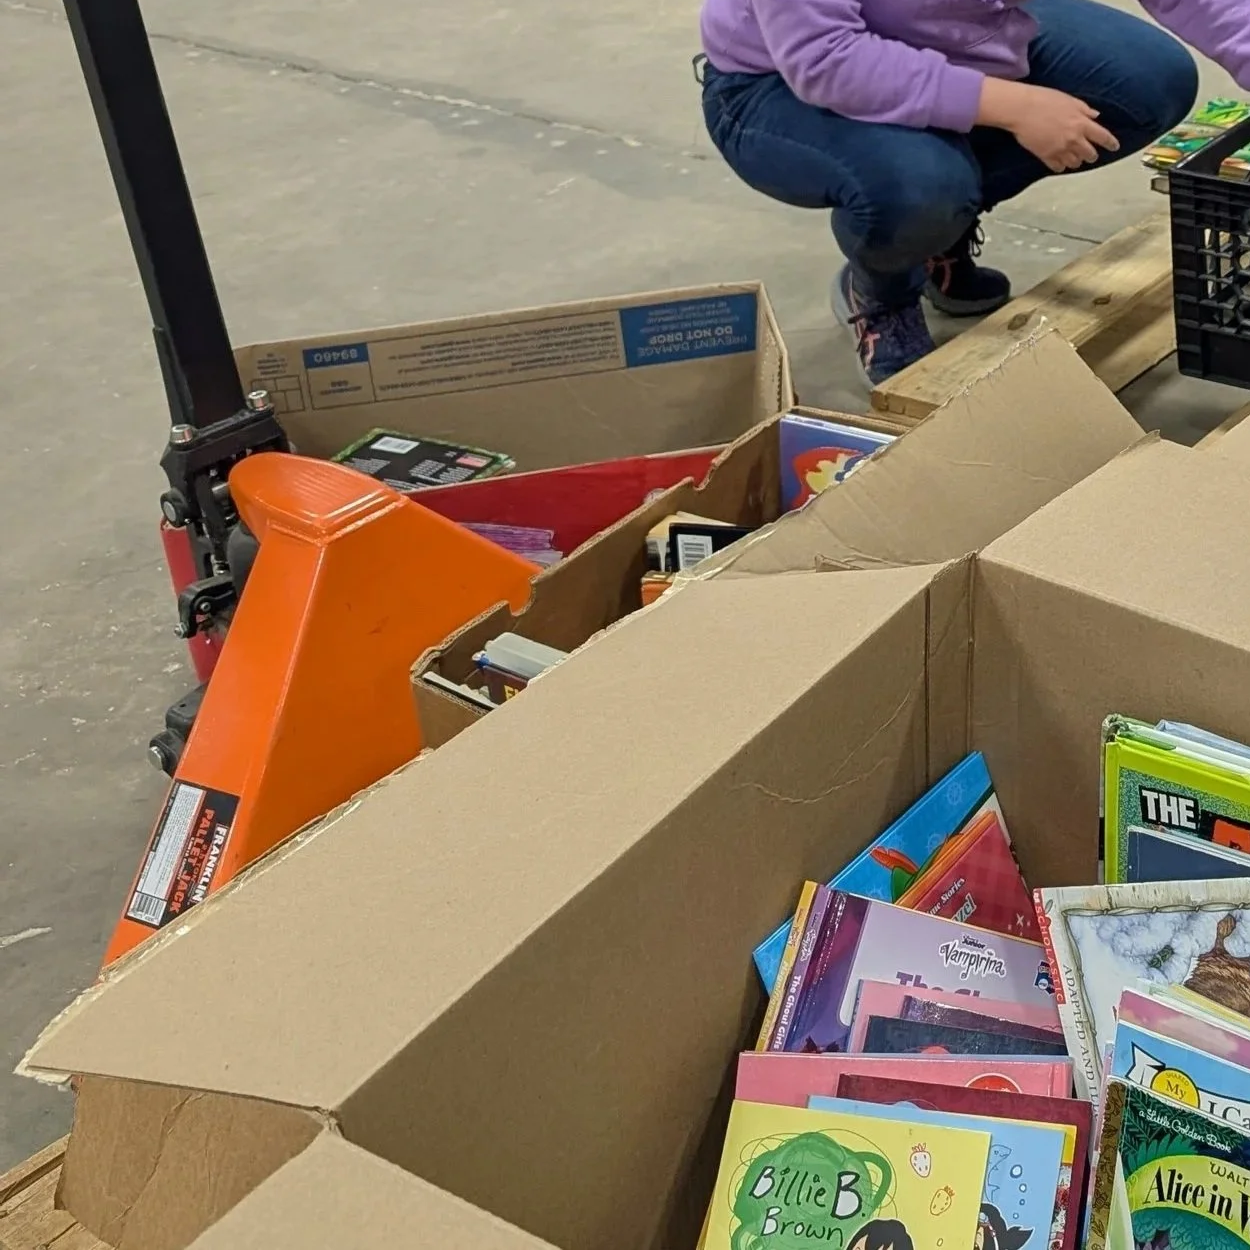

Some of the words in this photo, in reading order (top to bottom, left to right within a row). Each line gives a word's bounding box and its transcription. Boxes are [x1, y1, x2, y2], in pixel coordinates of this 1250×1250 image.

[649, 332, 683, 345] DROP
[687, 328, 712, 340] NOT
[694, 335, 748, 351] PREVENT
[714, 325, 733, 337] DO
[638, 340, 690, 358] DAMAGE
[1141, 789, 1198, 829] THE
[187, 808, 215, 867] PALLET
[191, 825, 228, 903] FRANKLIN
[169, 871, 192, 913] JACK
[940, 877, 966, 906] Stories
[961, 937, 986, 950] Junior
[1035, 905, 1064, 1003] SCHOLASTIC
[939, 941, 1006, 980] Vampirina
[789, 975, 802, 995] The
[782, 995, 796, 1027] Ghoul
[1063, 964, 1086, 1040] ADAPTED
[1080, 1046, 1095, 1081] AND
[773, 1026, 786, 1050] Girls
[1165, 1079, 1188, 1099] My
[1146, 1107, 1171, 1128] Little
[1171, 1119, 1205, 1143] Golden
[1206, 1132, 1232, 1154] Book
[1209, 1160, 1250, 1188] WALT
[749, 1165, 827, 1208] Billie
[831, 1170, 867, 1220] B.
[1142, 1165, 1206, 1207] Alice
[1209, 1184, 1235, 1221] in
[761, 1206, 844, 1248] Brown
